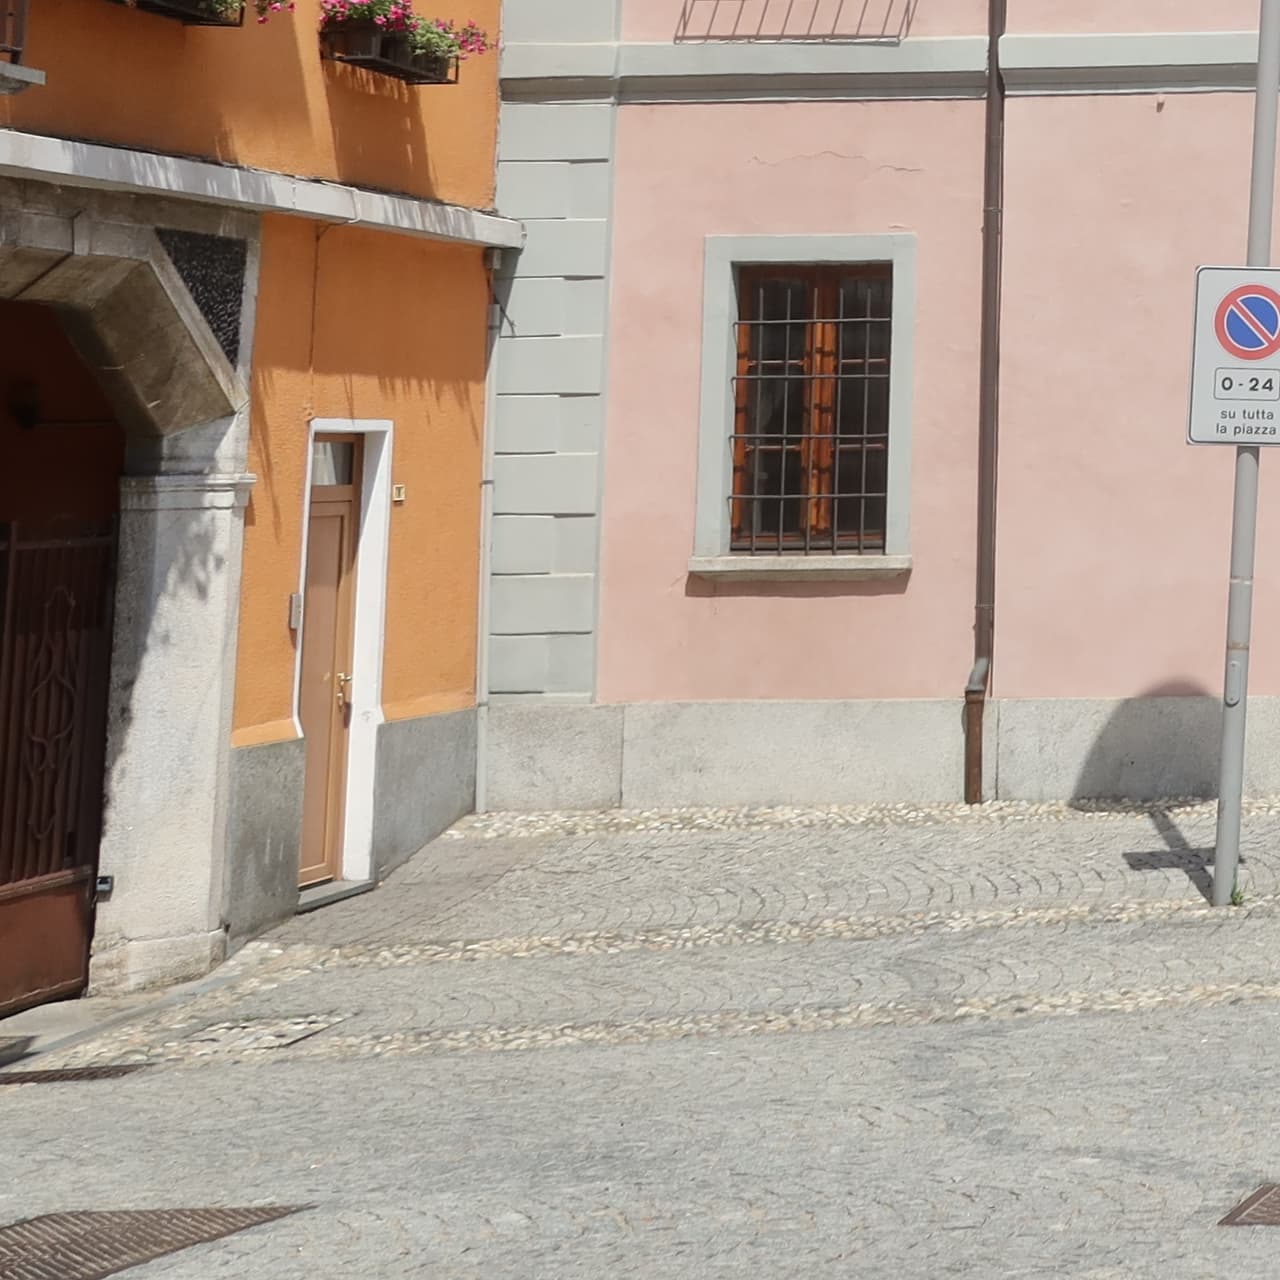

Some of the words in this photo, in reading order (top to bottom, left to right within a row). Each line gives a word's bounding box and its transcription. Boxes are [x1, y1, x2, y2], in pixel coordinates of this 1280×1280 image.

[1249, 377, 1274, 392] 24
[1220, 410, 1236, 420] su
[1242, 408, 1274, 420] tutta
[1216, 423, 1227, 434] la
[1233, 422, 1277, 437] piazza
